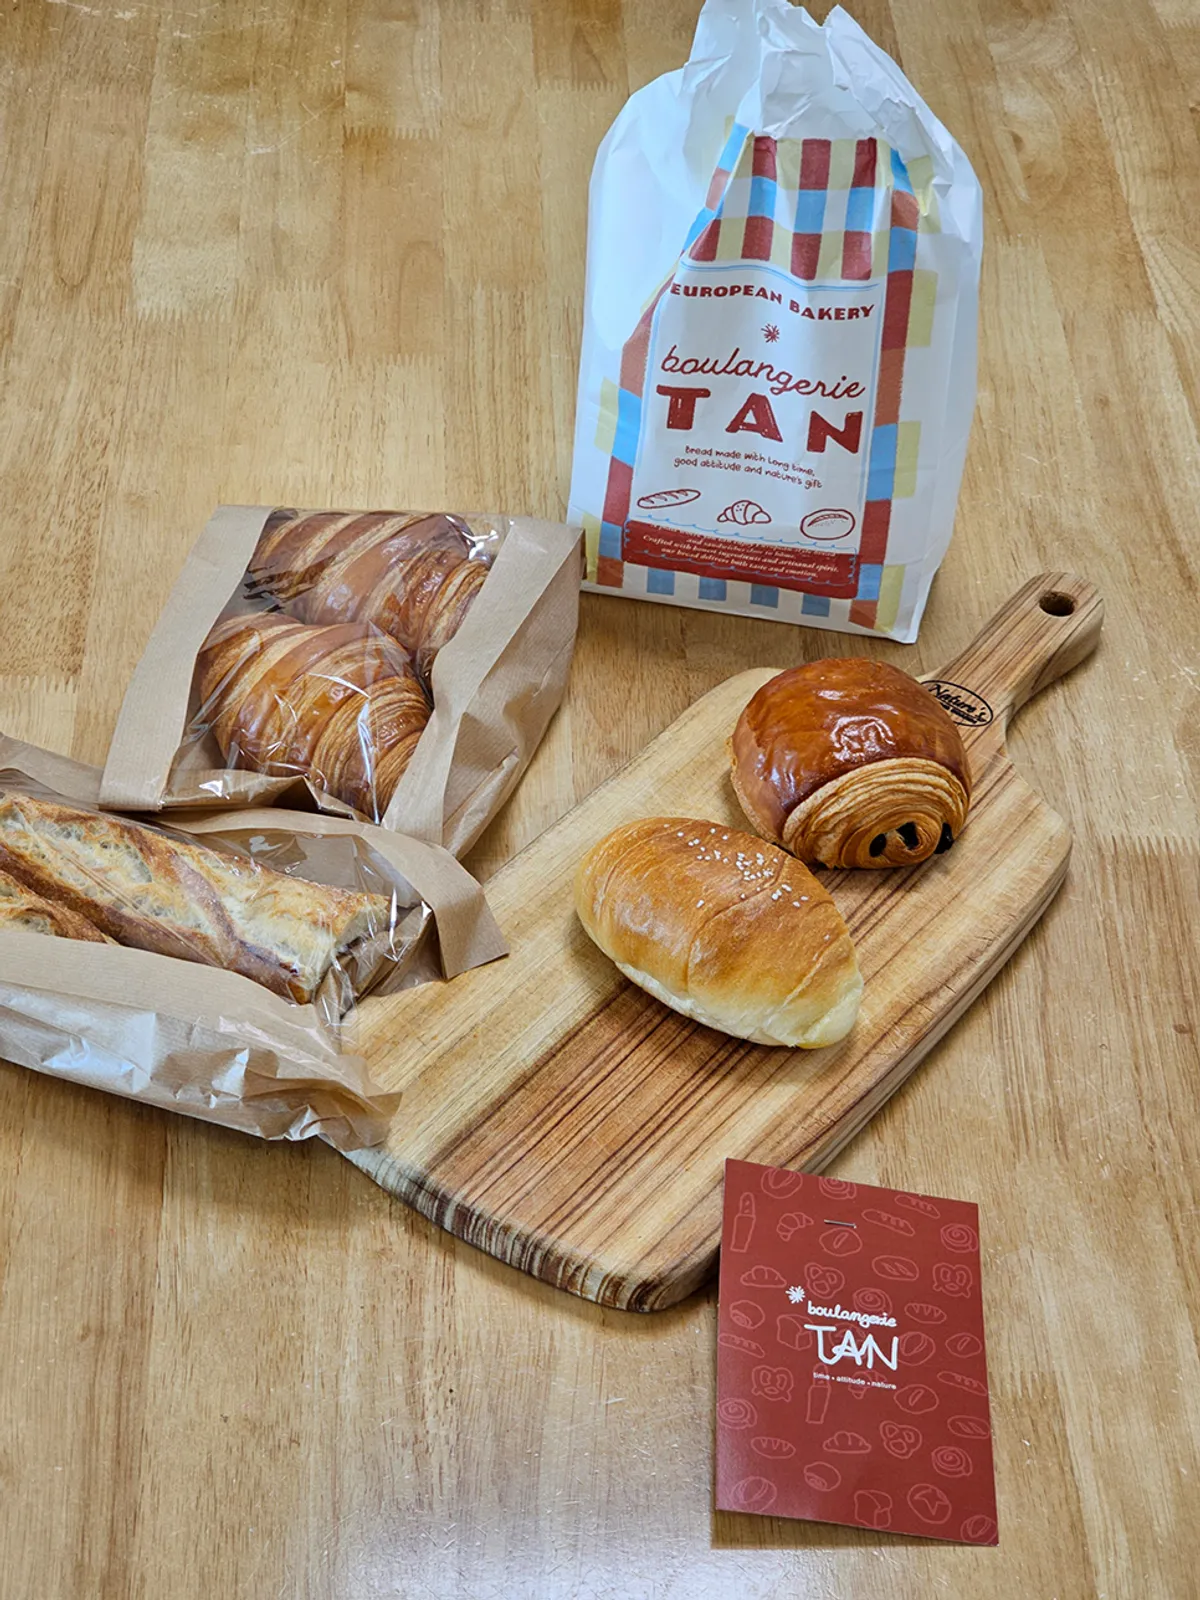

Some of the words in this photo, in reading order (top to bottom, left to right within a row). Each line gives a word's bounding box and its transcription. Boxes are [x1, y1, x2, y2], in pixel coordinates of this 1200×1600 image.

[670, 283, 782, 305] EUROPEAN
[788, 299, 875, 321] BAKERY
[660, 344, 866, 399] boulangerie
[656, 384, 864, 454] TAN
[715, 450, 741, 459] made
[744, 452, 765, 462] with
[673, 458, 698, 468] good
[700, 460, 741, 471] attitude
[744, 466, 762, 475] and
[765, 470, 802, 485] nature's
[804, 479, 822, 490] gift
[643, 534, 673, 547] Crafted
[673, 541, 692, 550] with
[677, 548, 699, 558] bread
[730, 558, 748, 567] both
[768, 565, 785, 573] and
[807, 1300, 897, 1328] boulangerie
[804, 1323, 899, 1371] TAN
